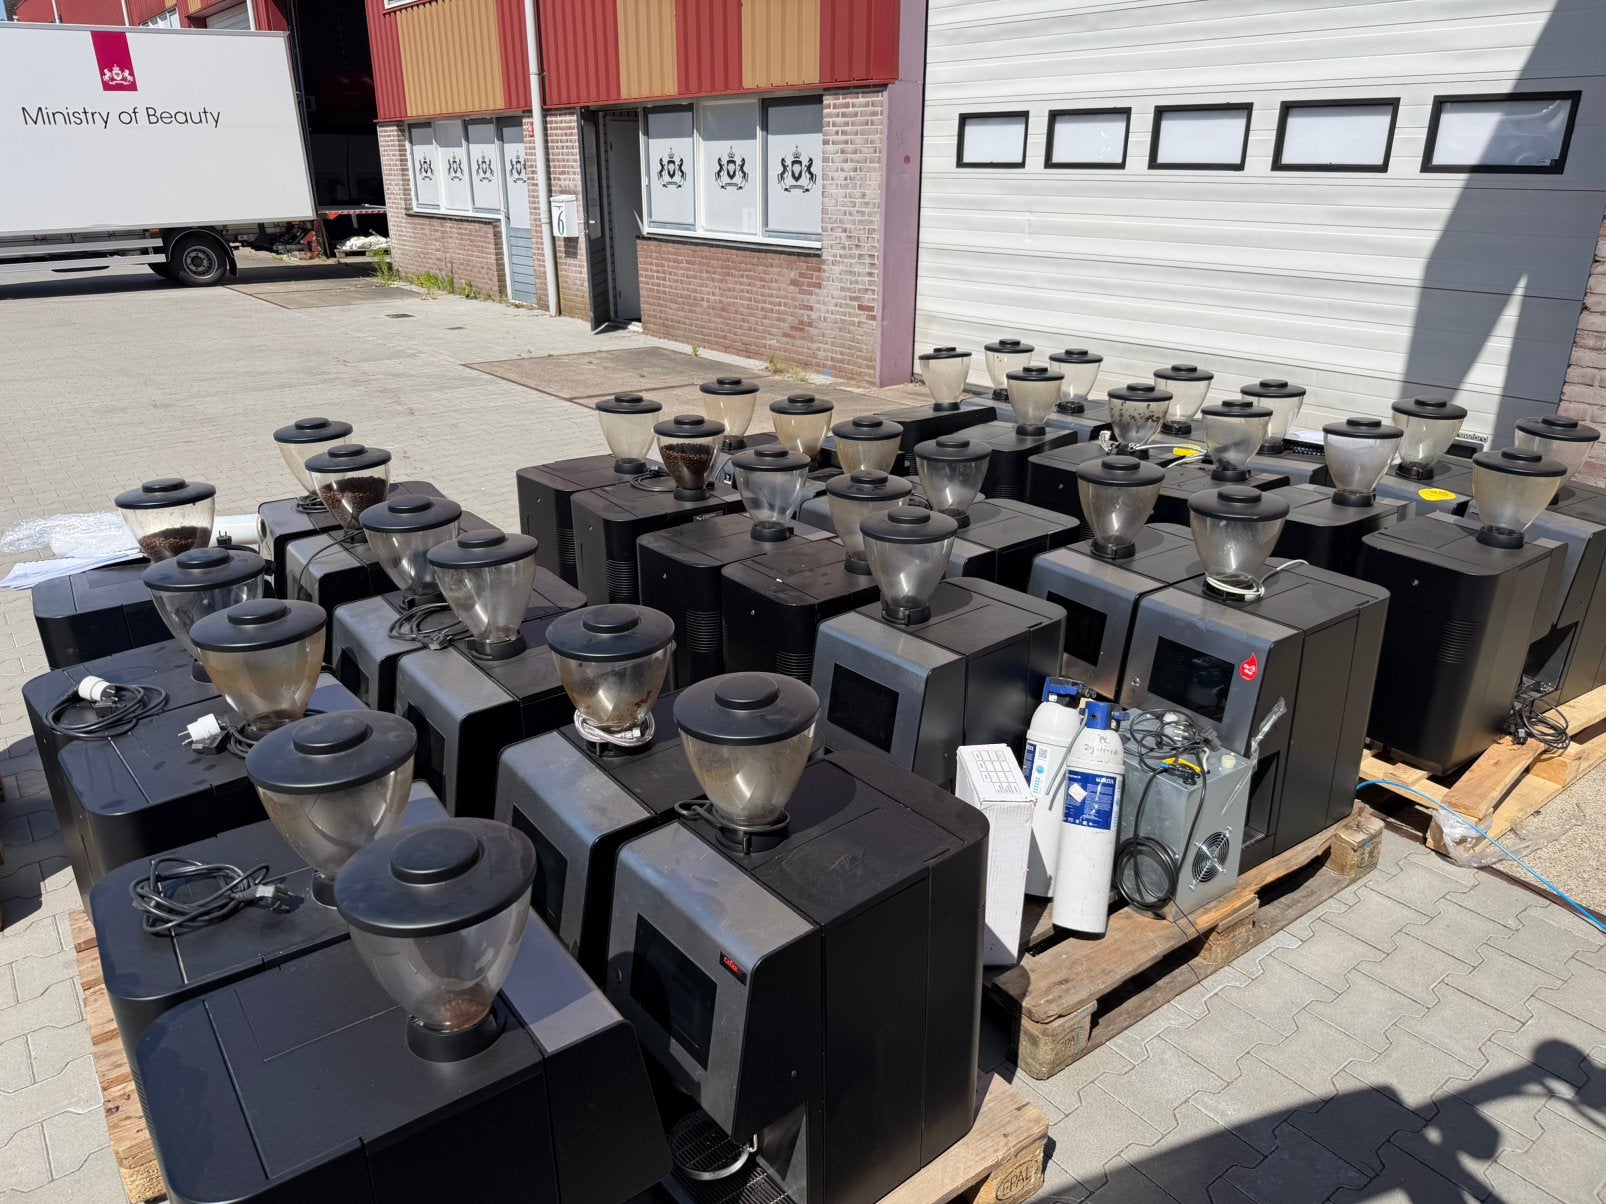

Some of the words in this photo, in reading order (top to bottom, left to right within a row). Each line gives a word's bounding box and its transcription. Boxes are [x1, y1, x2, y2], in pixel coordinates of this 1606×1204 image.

[21, 106, 110, 130] Ministry
[118, 106, 139, 125] of
[145, 106, 221, 129] Beauty
[557, 210, 565, 236] 6
[1001, 1166, 1032, 1198] EPAL
